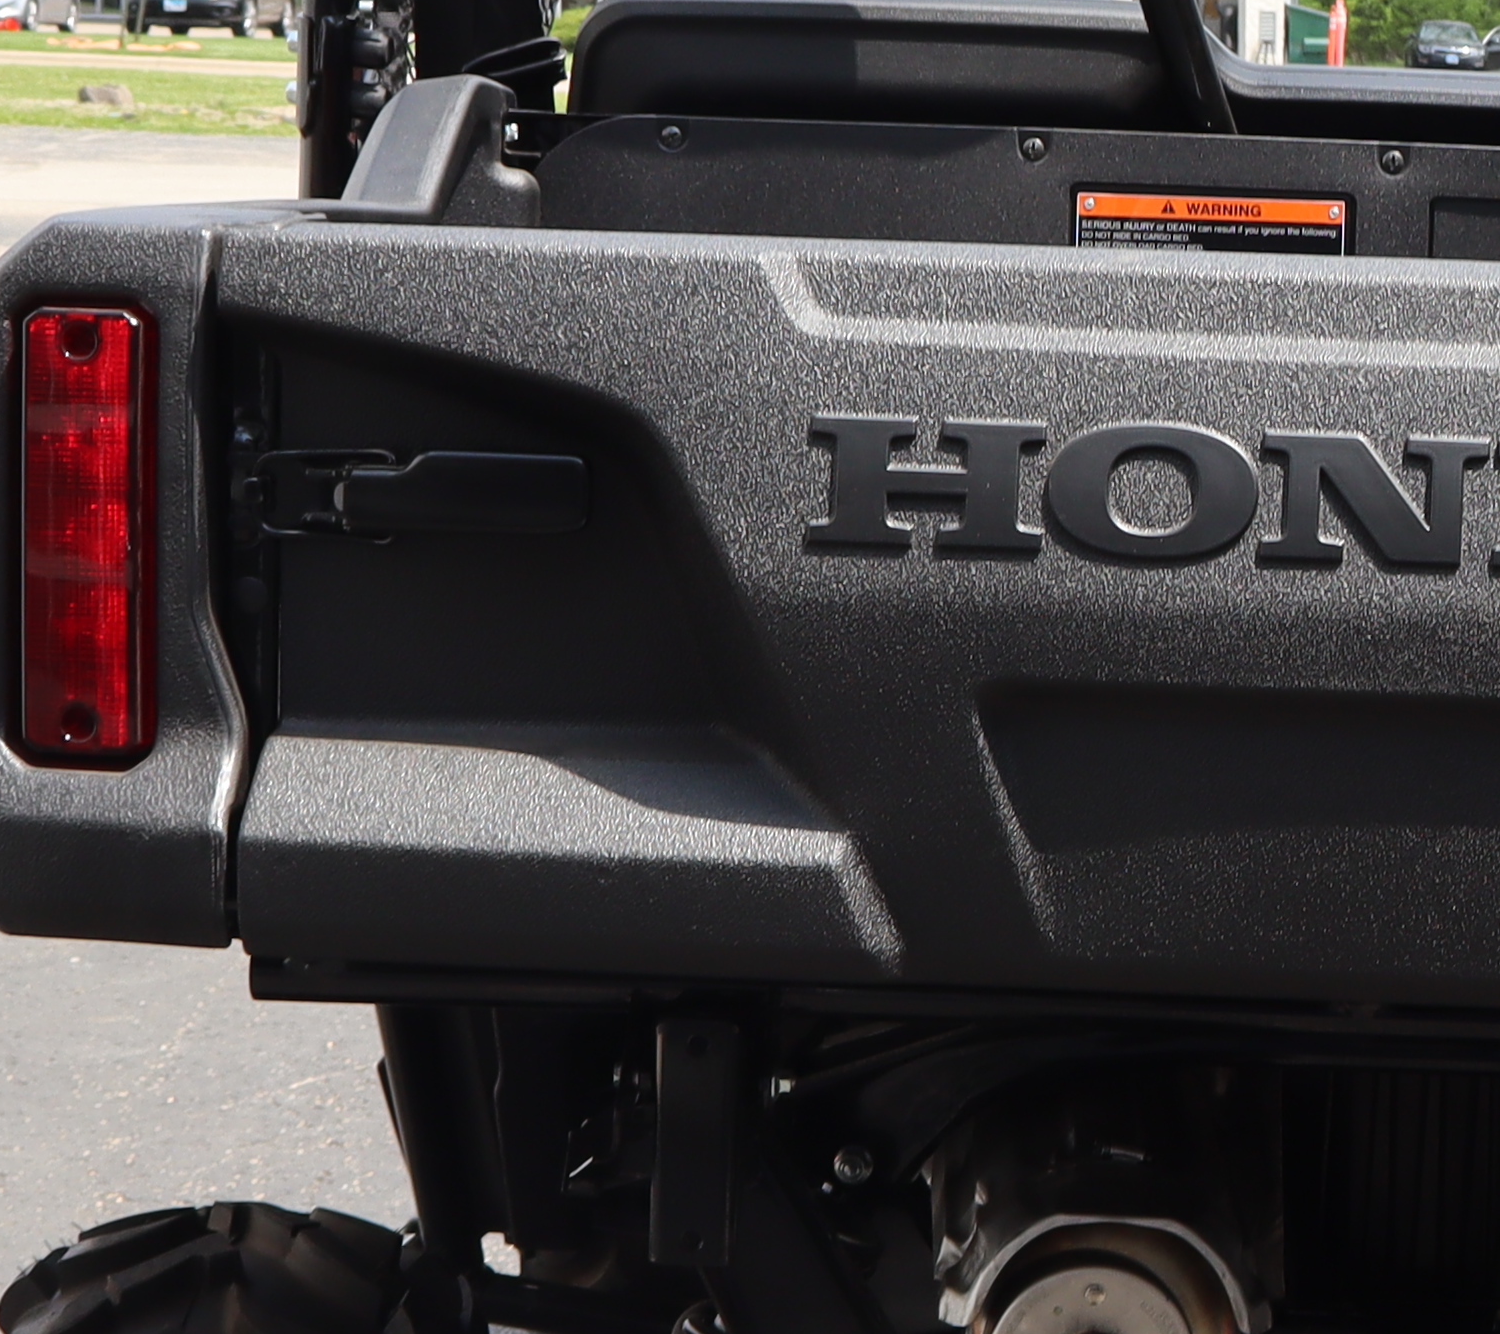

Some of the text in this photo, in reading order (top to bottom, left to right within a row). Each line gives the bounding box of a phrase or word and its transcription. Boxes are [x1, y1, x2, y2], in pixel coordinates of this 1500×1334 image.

[1186, 203, 1262, 217] WARNING
[1081, 219, 1121, 230] SERIOUS
[1123, 220, 1155, 231] INJURY
[1156, 223, 1165, 231] or
[1167, 222, 1196, 233] DEATH
[1198, 225, 1213, 233] can
[1214, 224, 1236, 234] result
[1245, 227, 1259, 237] you
[1261, 226, 1286, 237] ignore
[1288, 227, 1300, 236] the
[1081, 230, 1093, 239] DO
[1095, 231, 1111, 240] NOT
[1113, 231, 1132, 240] RIDE
[1133, 232, 1142, 241] IN
[1143, 232, 1171, 241] CARGO
